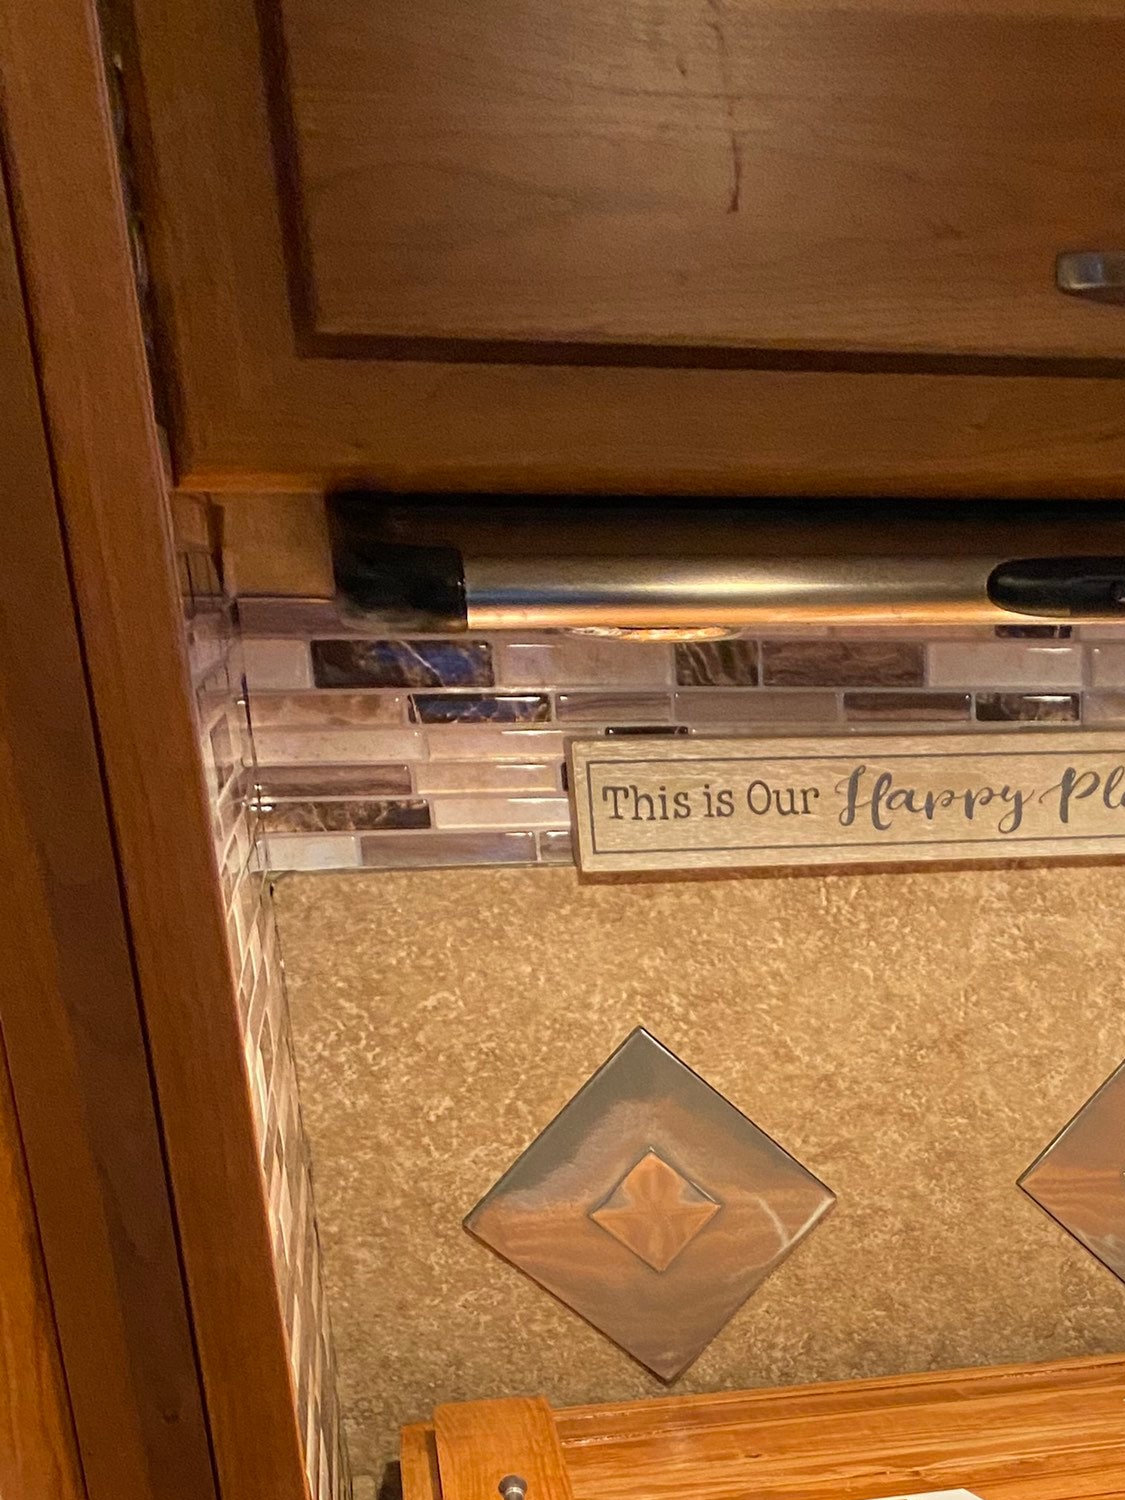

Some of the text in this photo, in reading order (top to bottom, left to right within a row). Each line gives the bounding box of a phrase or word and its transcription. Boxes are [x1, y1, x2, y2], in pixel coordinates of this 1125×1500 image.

[602, 784, 692, 822] This
[702, 784, 735, 819] is
[745, 780, 822, 816] Our
[835, 764, 1036, 834] Happy
